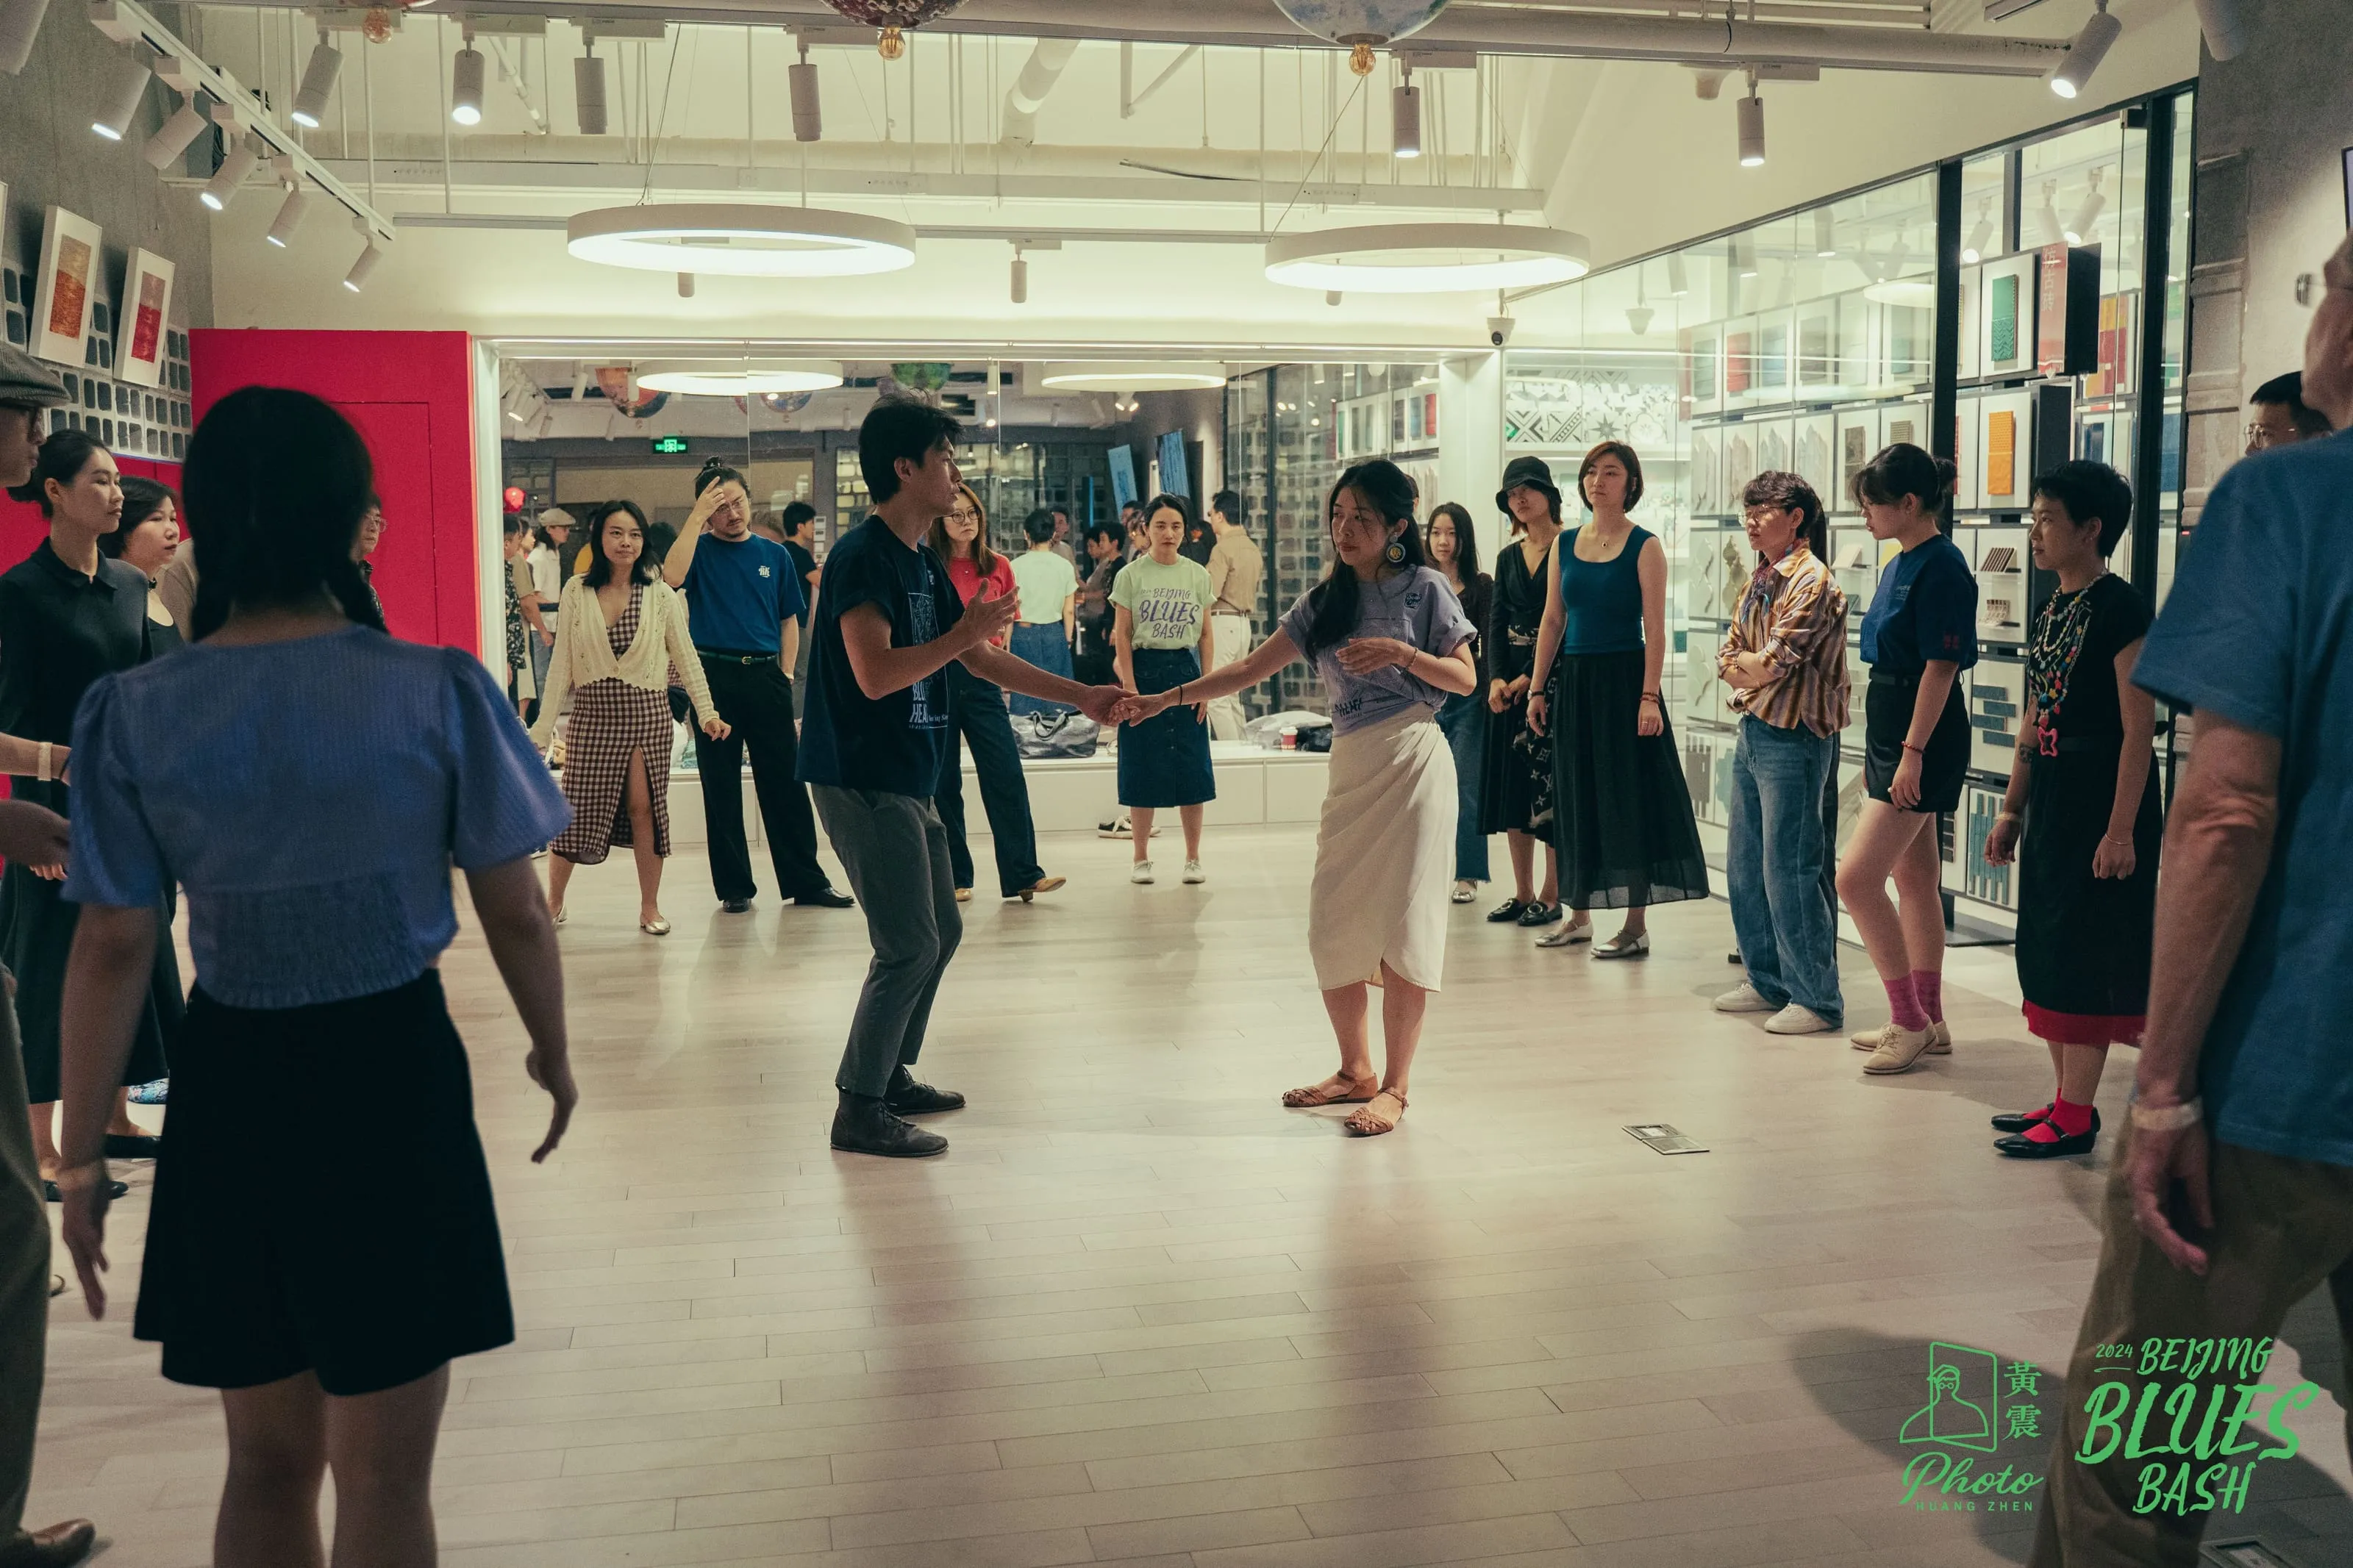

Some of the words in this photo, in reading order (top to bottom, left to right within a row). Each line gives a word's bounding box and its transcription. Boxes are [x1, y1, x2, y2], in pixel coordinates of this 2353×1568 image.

[1153, 587, 1191, 600] BEIJING
[1139, 599, 1200, 625] BLUES
[1152, 623, 1186, 640] BASH
